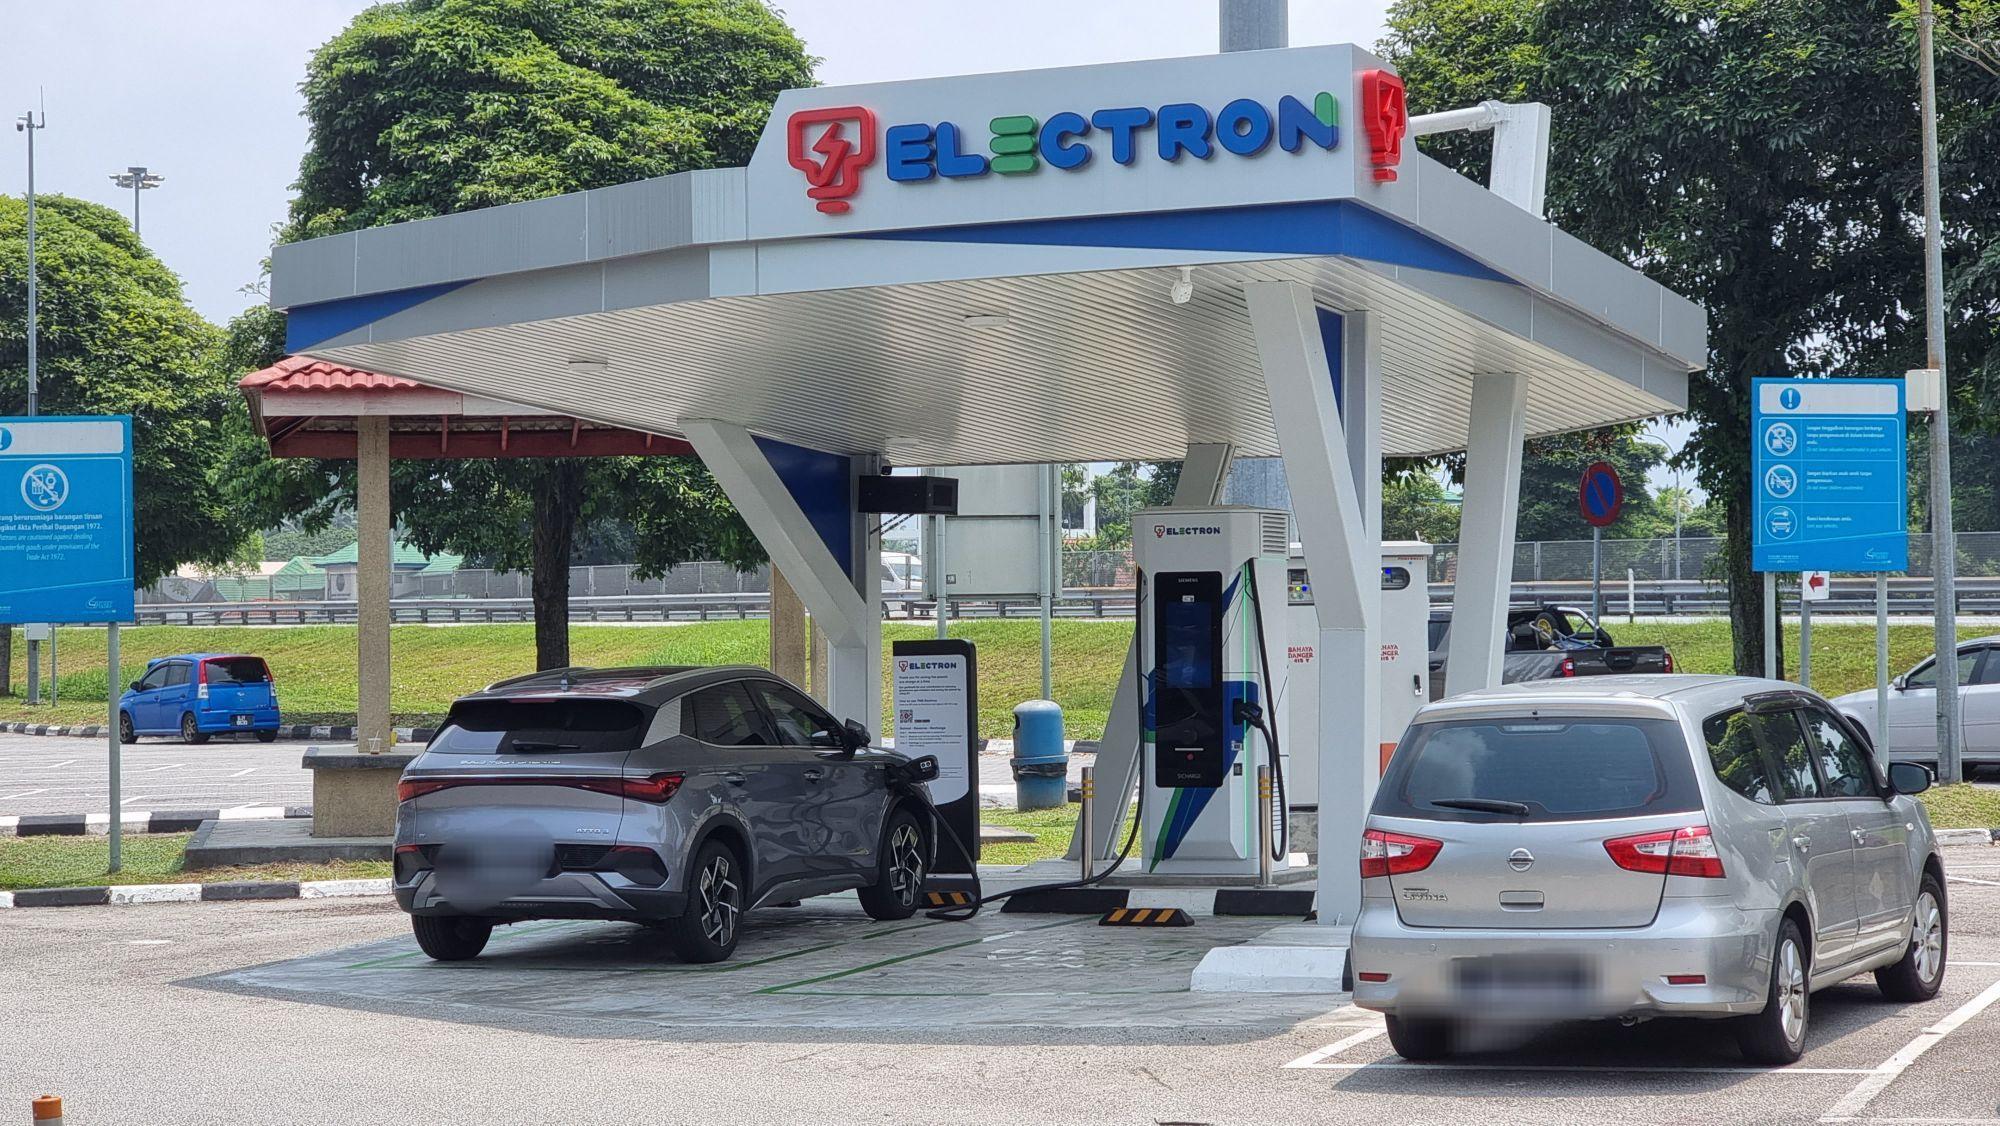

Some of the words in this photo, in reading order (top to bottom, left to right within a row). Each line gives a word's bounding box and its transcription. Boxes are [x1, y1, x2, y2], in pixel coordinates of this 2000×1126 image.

[886, 91, 1340, 182] ELECTRON
[54, 512, 84, 521] barangan
[54, 522, 85, 531] Dagangan
[1166, 527, 1220, 535] ELECTRON
[909, 662, 957, 670] ELECTRON
